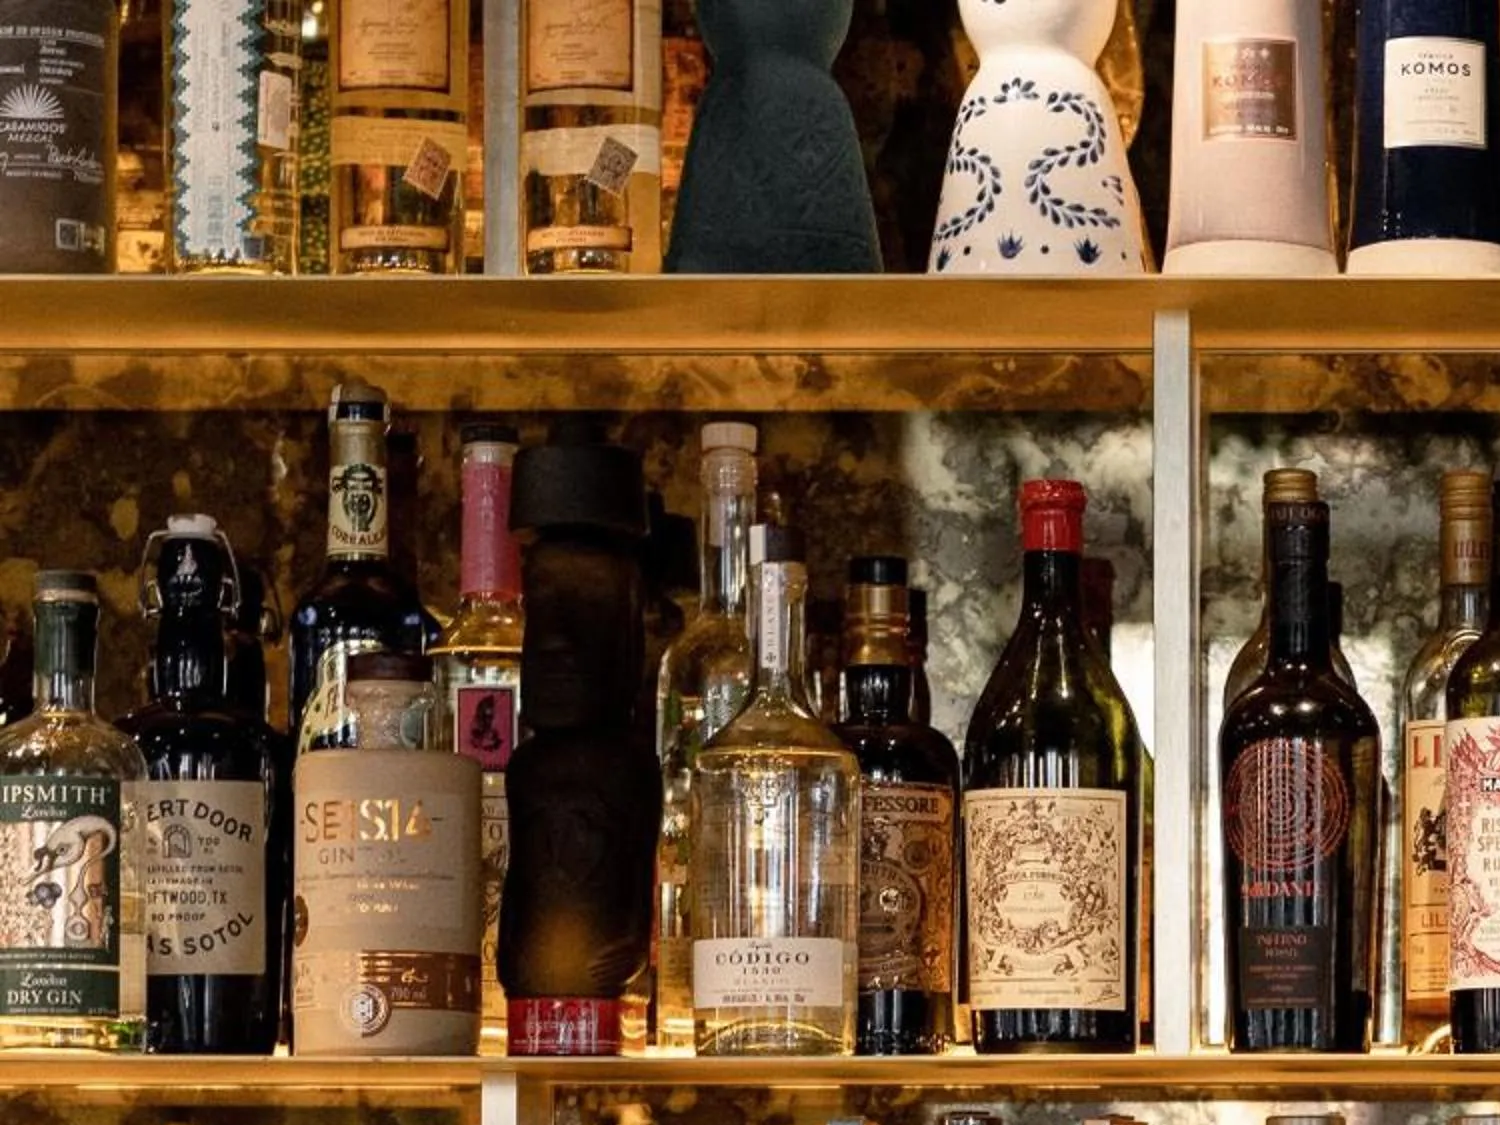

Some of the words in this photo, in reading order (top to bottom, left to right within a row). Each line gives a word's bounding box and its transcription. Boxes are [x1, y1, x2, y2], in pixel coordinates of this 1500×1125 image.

[1400, 61, 1472, 77] KOMOS
[193, 801, 252, 843] DOOR
[319, 847, 355, 865] GIN
[182, 911, 254, 956] SOTOL
[715, 949, 810, 965] CÓDIGO
[7, 989, 43, 1005] DRY
[47, 988, 84, 1004] GIN
